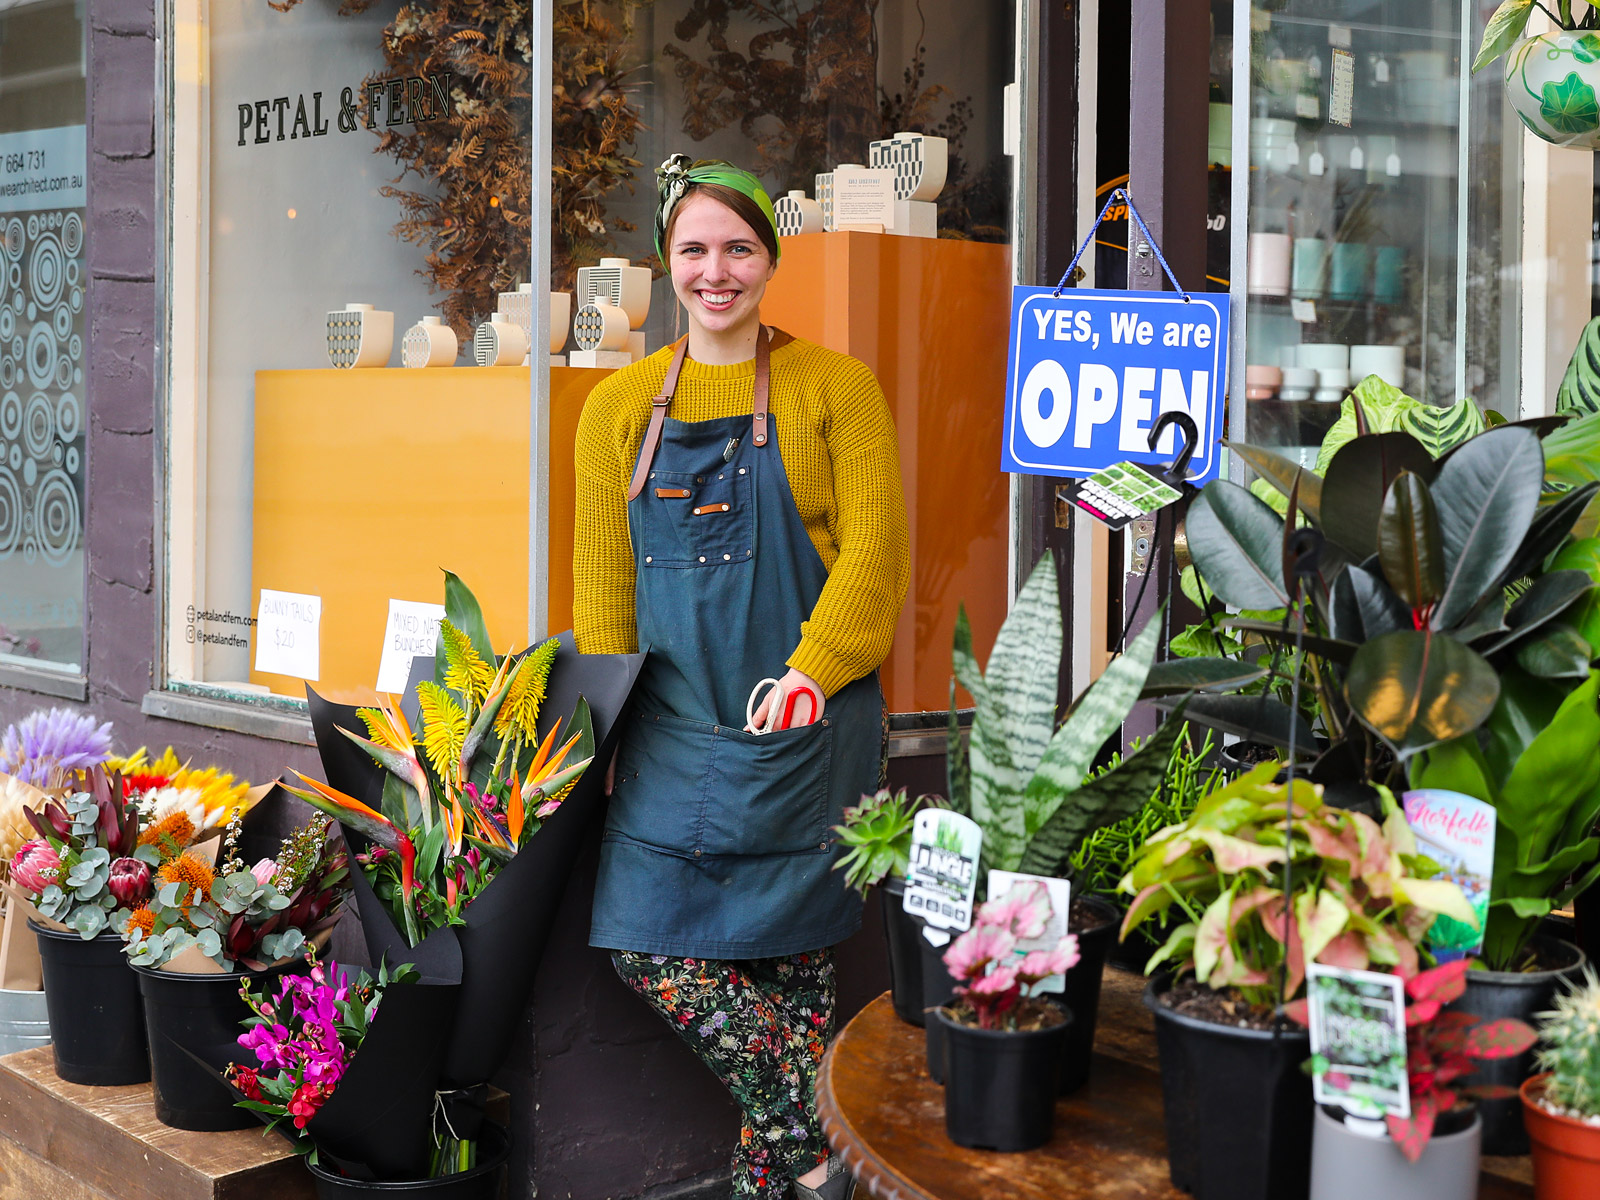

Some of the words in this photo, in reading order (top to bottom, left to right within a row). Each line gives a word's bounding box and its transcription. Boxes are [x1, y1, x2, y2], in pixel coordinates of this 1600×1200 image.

[237, 91, 329, 147] PETAL
[337, 86, 358, 133] &
[366, 72, 451, 129] FERN
[6, 153, 24, 174] 664
[27, 149, 46, 170] 731
[1033, 308, 1100, 351] YES,
[1110, 311, 1154, 346] We
[1162, 321, 1212, 349] are
[1020, 358, 1209, 459] OPEN
[1076, 489, 1126, 520] BASKET
[1080, 480, 1142, 519] DESIGNER
[264, 598, 289, 617] BUNNY
[290, 602, 315, 624] TAILS
[393, 611, 419, 634] MIXED
[274, 626, 296, 651] $20
[394, 633, 434, 656] BUNCHES
[1407, 797, 1489, 835] Norfolk
